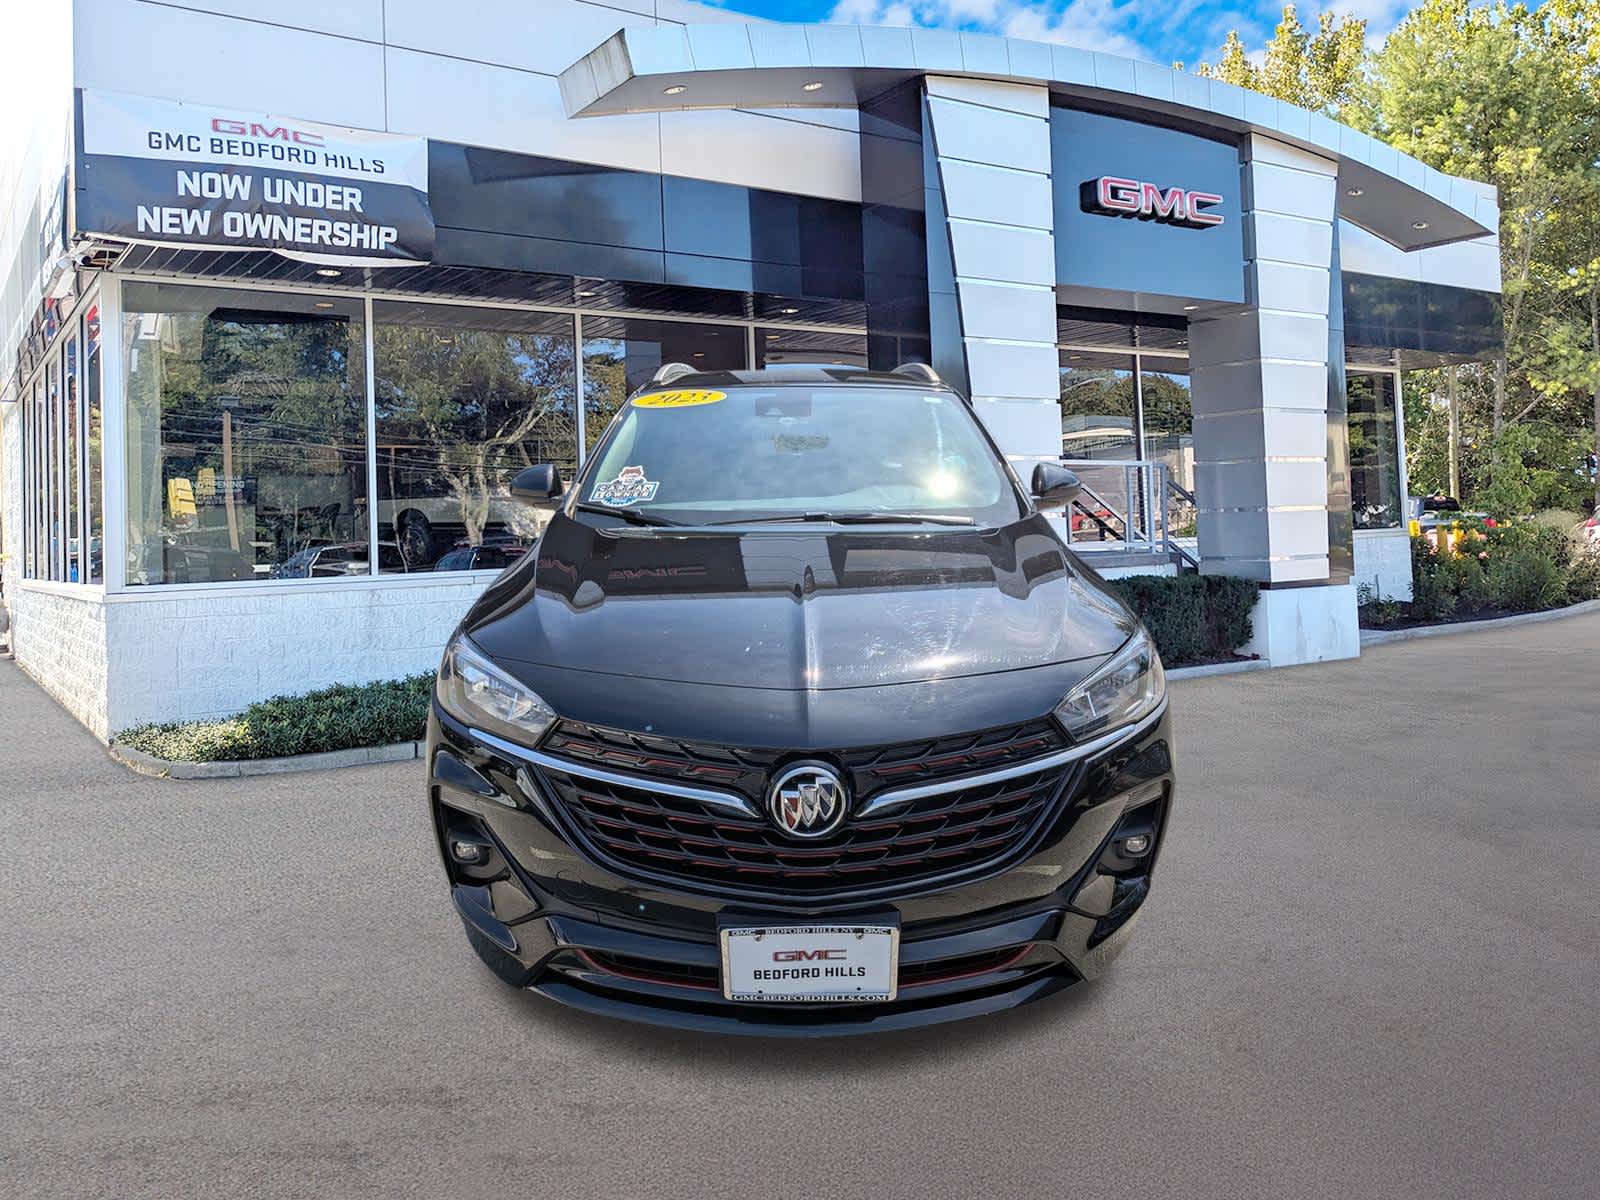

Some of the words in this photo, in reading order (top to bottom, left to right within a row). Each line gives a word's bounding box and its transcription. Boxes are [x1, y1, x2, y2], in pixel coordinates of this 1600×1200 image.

[148, 131, 201, 152] GMC
[210, 138, 317, 165] BEDFORD
[324, 154, 385, 174] HILLS
[211, 117, 325, 147] GMC
[177, 170, 252, 201] NOW
[263, 177, 364, 212] UNDER
[1097, 175, 1225, 225] GMC
[137, 206, 211, 236] NEW
[224, 211, 398, 250] OWNERSHIP
[753, 968, 820, 980] BEDFORD
[825, 967, 866, 977] HILLS
[773, 949, 847, 962] GMC
